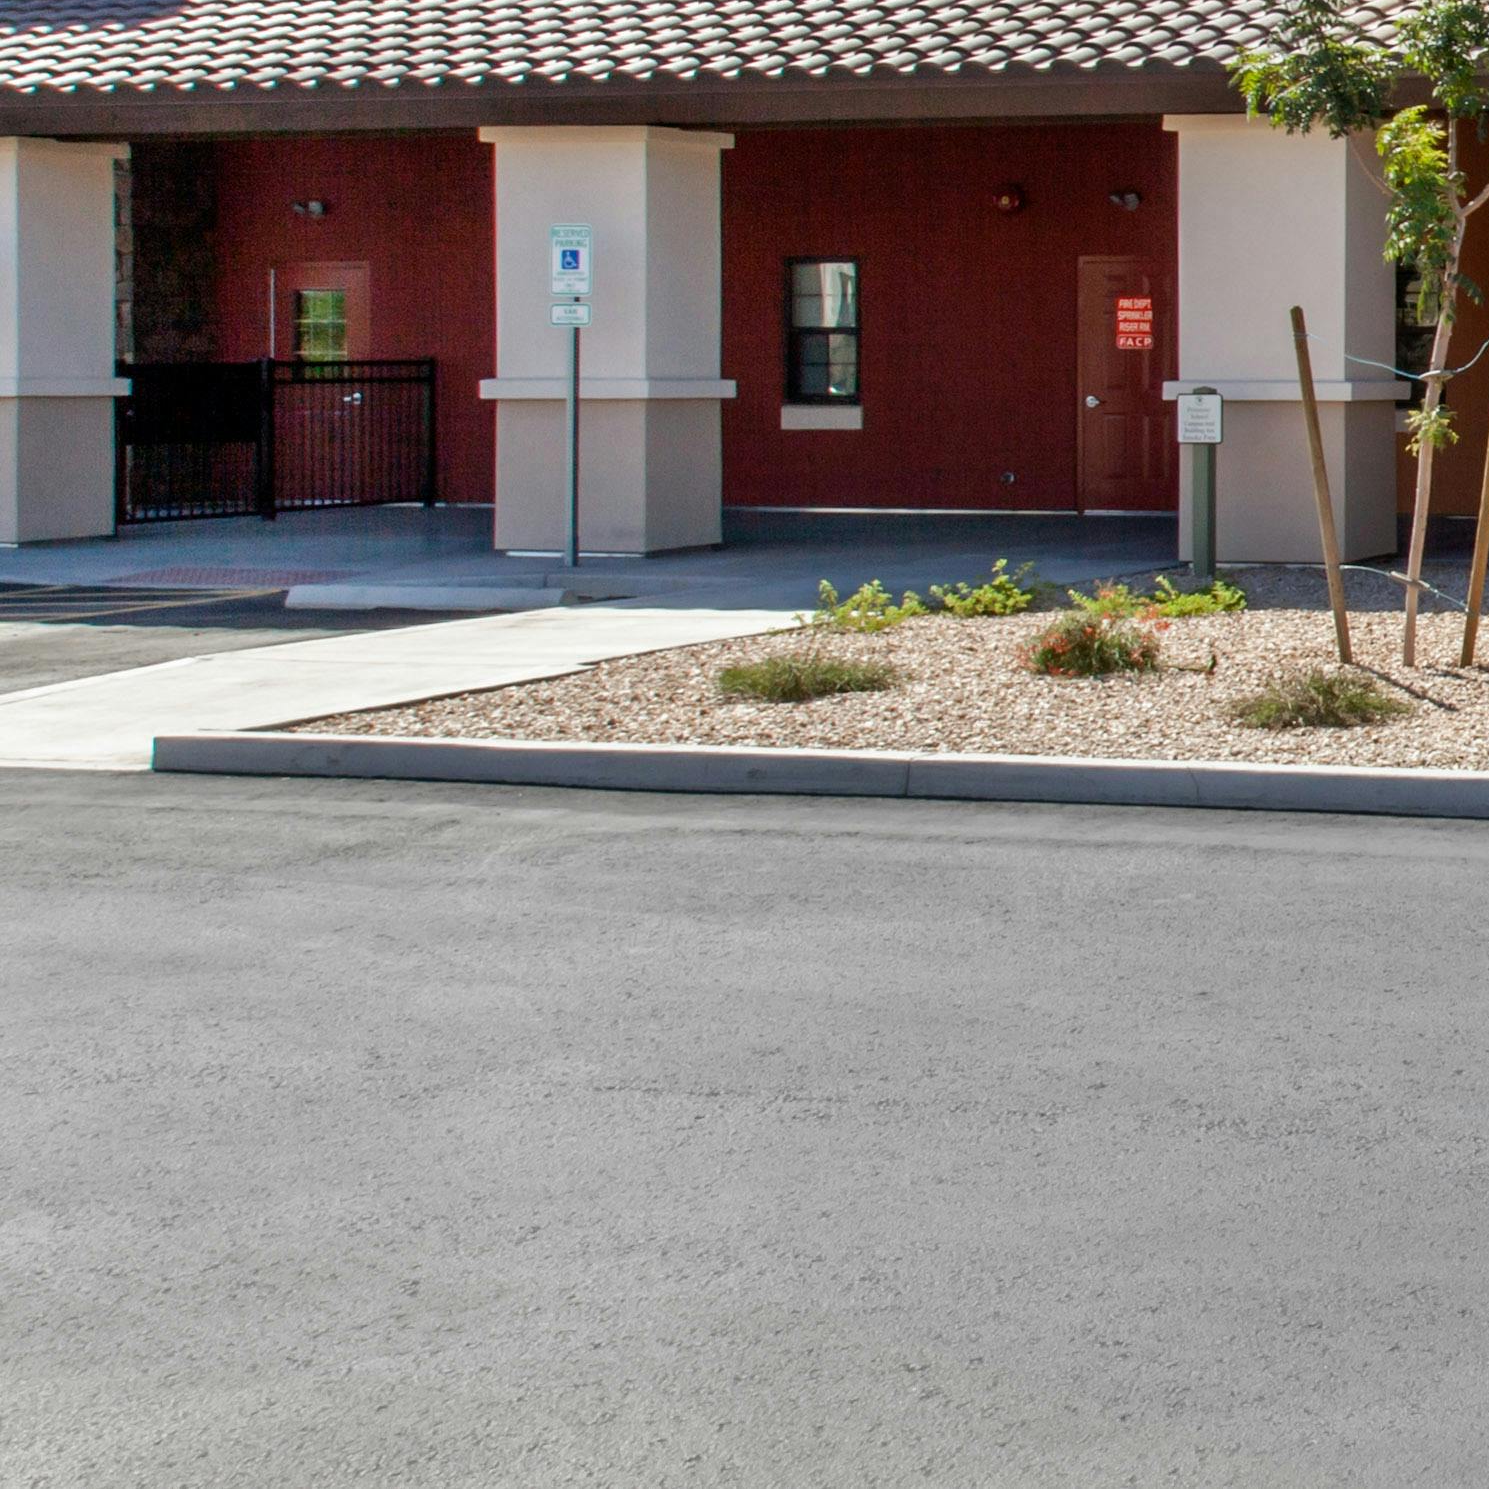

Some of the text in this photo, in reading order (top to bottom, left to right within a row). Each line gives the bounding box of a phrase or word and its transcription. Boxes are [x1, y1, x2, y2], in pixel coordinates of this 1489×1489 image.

[551, 229, 590, 238] SERVED
[1118, 298, 1133, 309] FIRE
[1117, 310, 1153, 321] SPRINKLER
[1119, 322, 1138, 332] RISER
